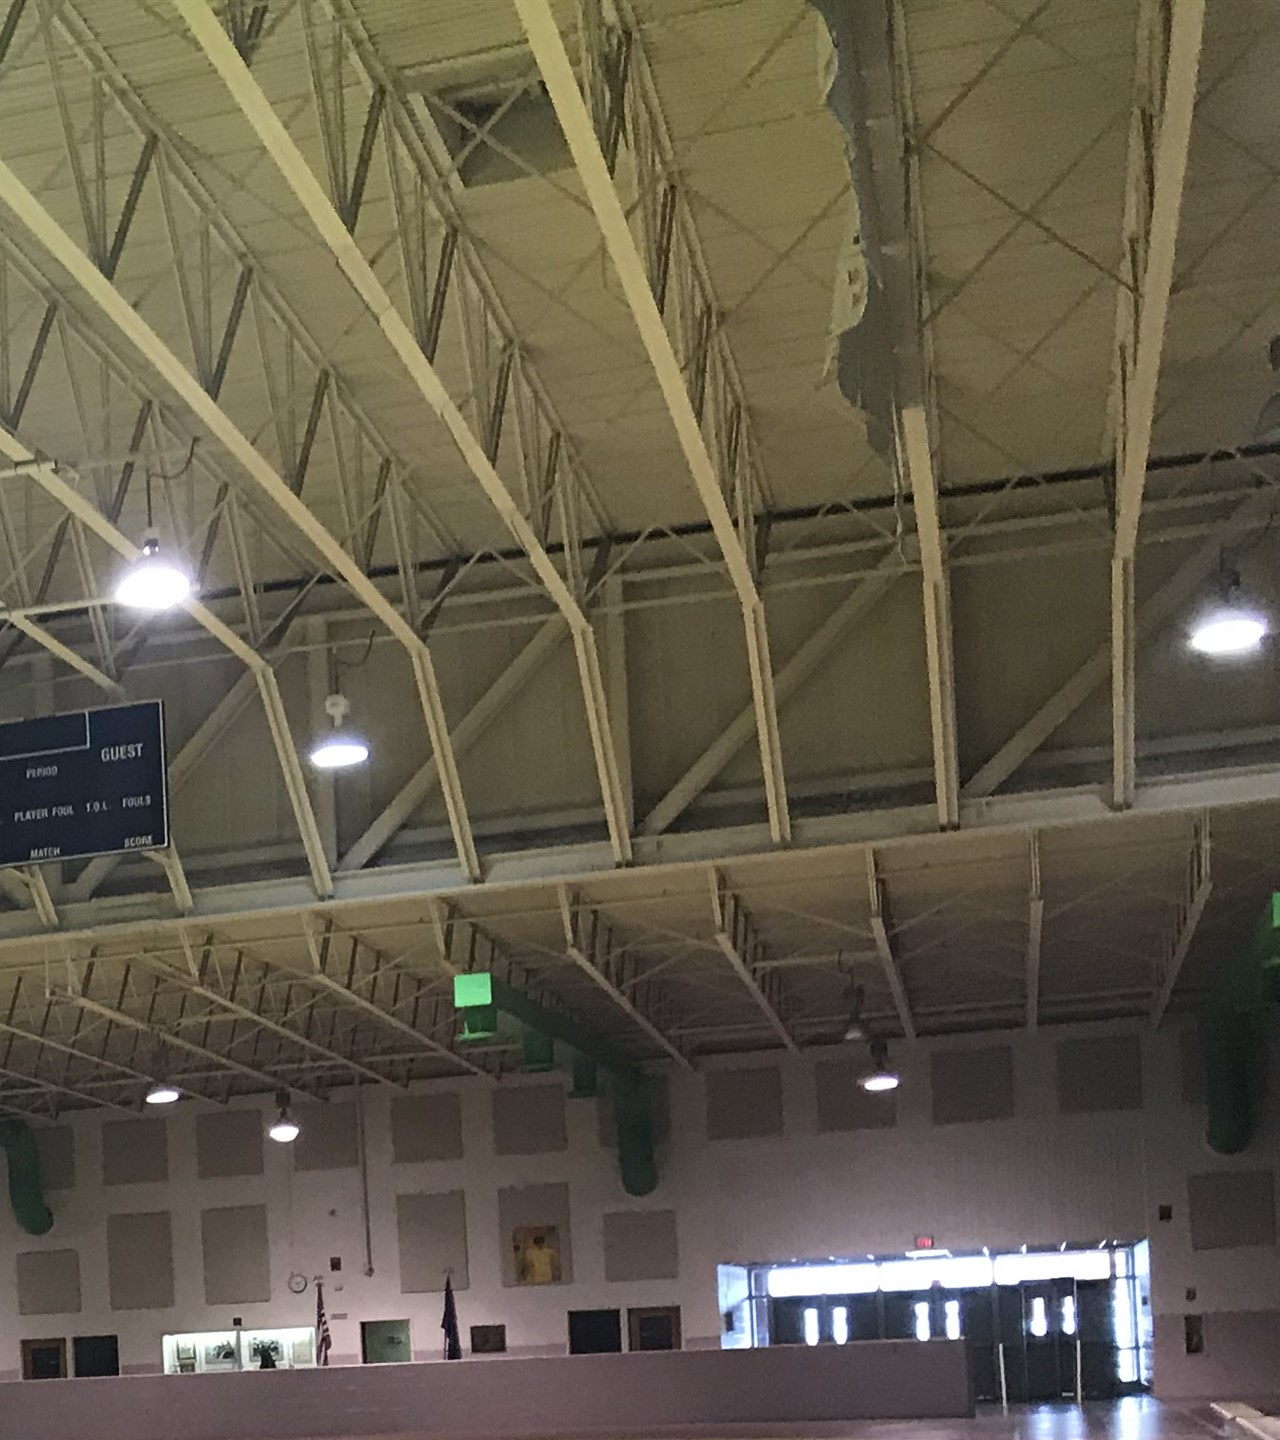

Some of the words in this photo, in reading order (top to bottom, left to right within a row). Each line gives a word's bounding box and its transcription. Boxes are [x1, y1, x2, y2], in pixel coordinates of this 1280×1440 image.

[101, 743, 143, 762] GUEST
[26, 765, 58, 779] PERIOD
[122, 795, 151, 808] FOULS
[14, 808, 48, 822] PLAYER
[52, 805, 74, 817] FOUL
[124, 835, 153, 848] SCORE
[30, 846, 60, 860] MATCH
